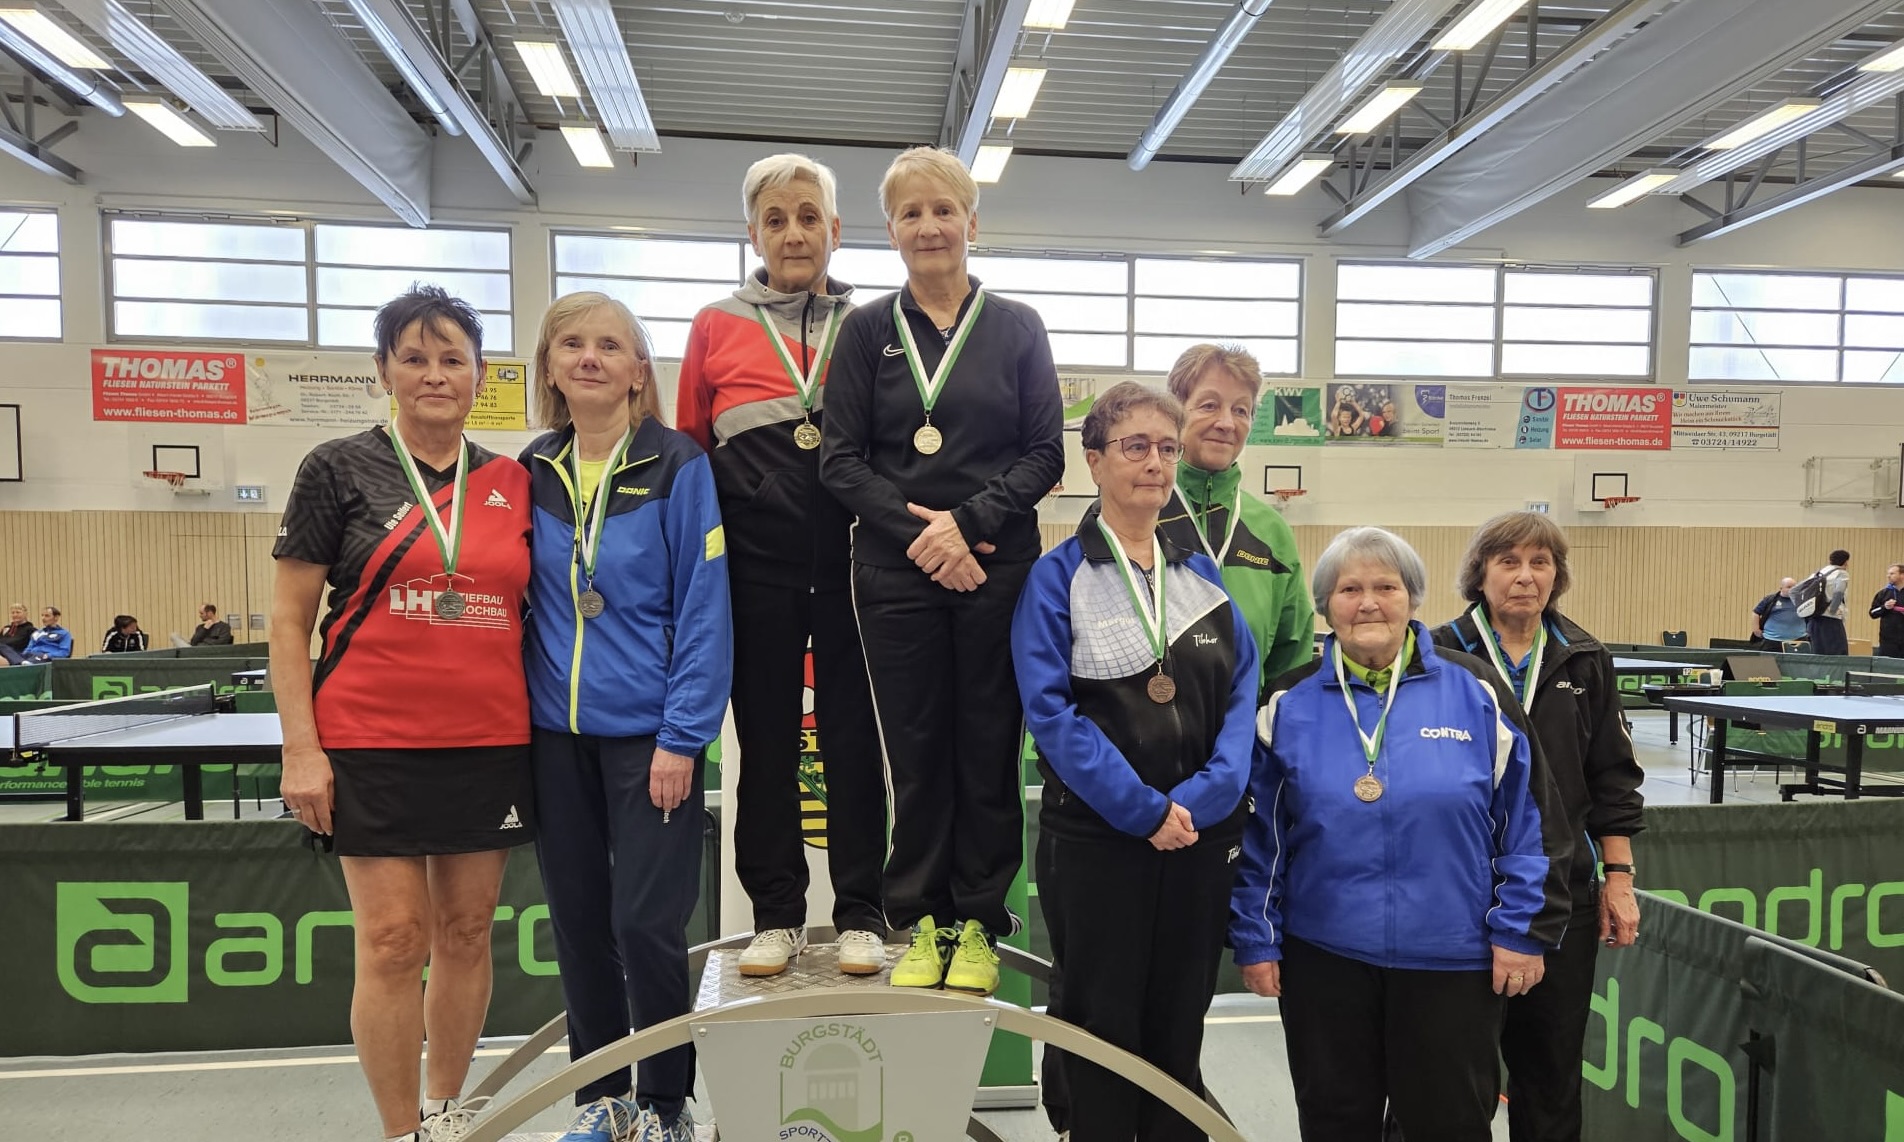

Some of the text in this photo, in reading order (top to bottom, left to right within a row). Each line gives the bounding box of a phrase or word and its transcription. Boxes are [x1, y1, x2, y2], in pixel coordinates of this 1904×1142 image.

[289, 375, 376, 384] HERRMANN
[103, 380, 230, 391] FLIESEN NATURSTEIN PARKETT
[1275, 387, 1304, 397] KWV
[1688, 393, 1760, 403] Uwe Schumann
[103, 406, 238, 420] www.fliesen-thomas.de
[1629, 414, 1659, 422] PARKETT
[1421, 427, 1440, 435] Sport
[1562, 437, 1663, 446] www.fliesen-thomas.de
[1701, 439, 1758, 447] 03724/14922
[616, 486, 651, 496] DONIC
[383, 519, 399, 531] Ute
[1236, 549, 1269, 566] DONIC
[1420, 727, 1472, 742] CONTRA
[104, 778, 145, 788] tennis
[779, 1022, 883, 1070] BURGSTÄDT
